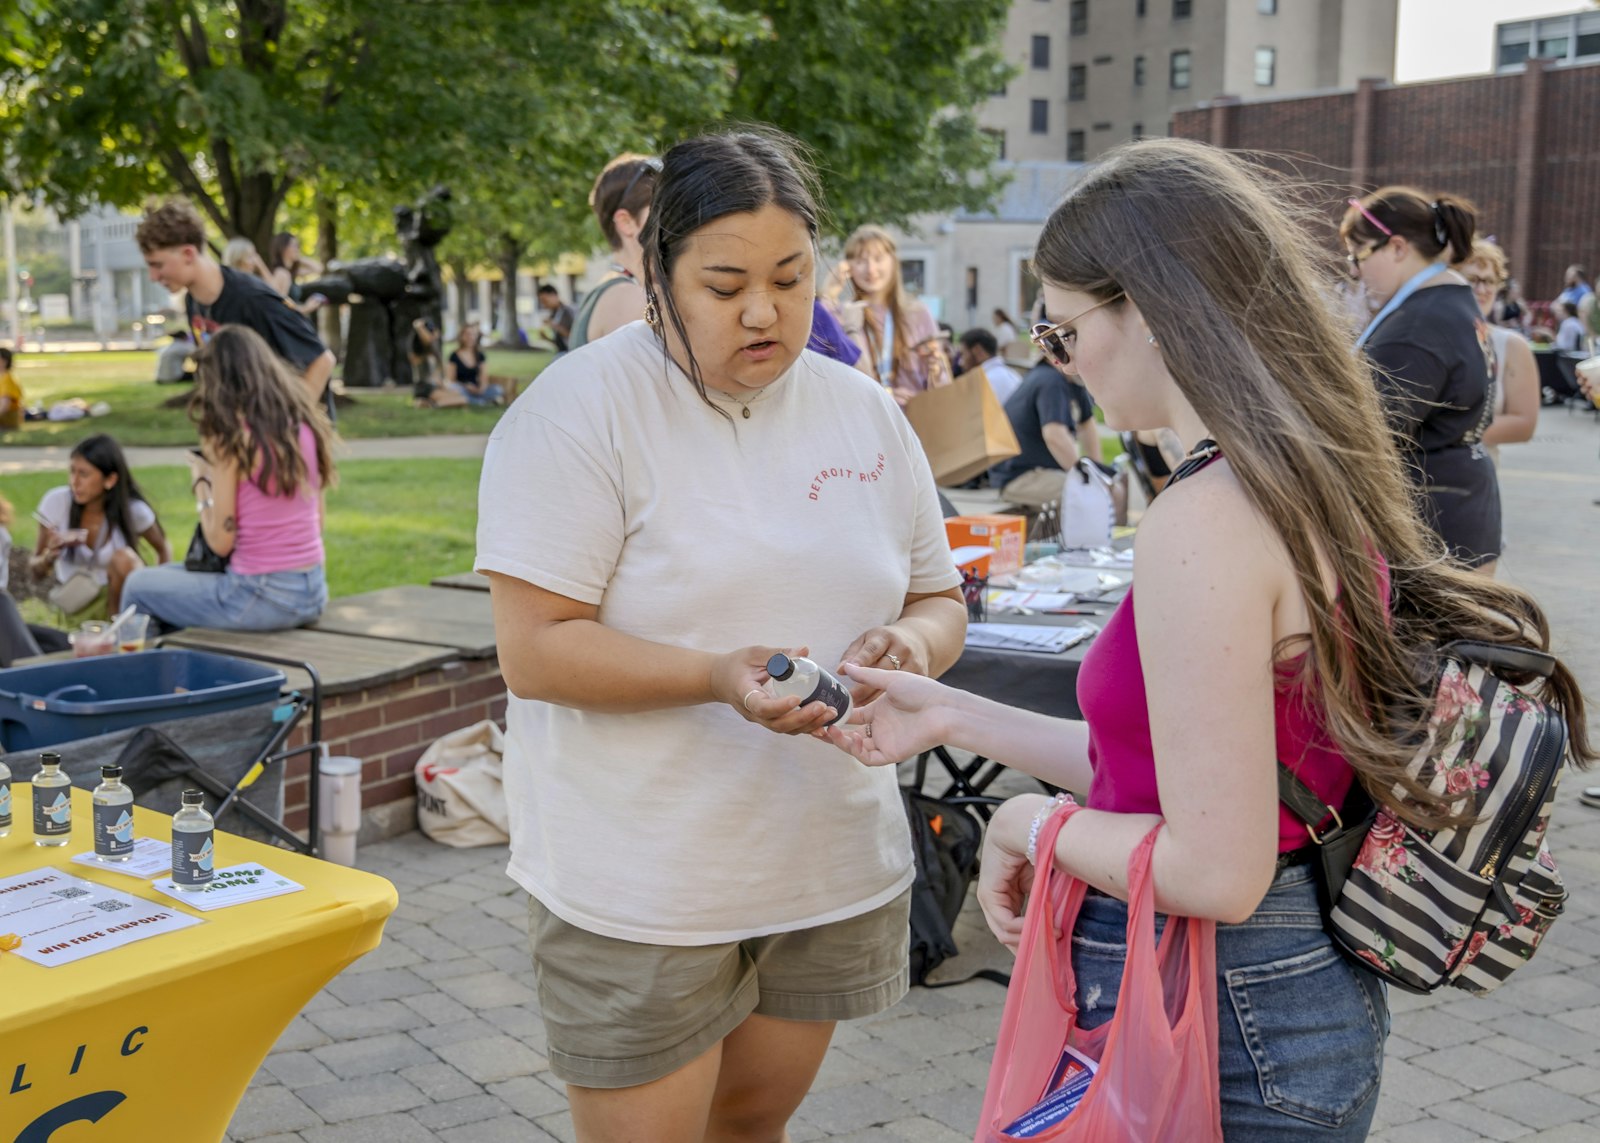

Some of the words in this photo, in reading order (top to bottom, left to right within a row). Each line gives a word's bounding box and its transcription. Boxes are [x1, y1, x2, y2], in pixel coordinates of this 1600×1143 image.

[808, 468, 852, 501] DETROIT
[859, 453, 885, 483] RISING
[38, 942, 71, 955] WIN
[69, 931, 106, 945] FREE
[106, 912, 173, 934] AIRPODS!
